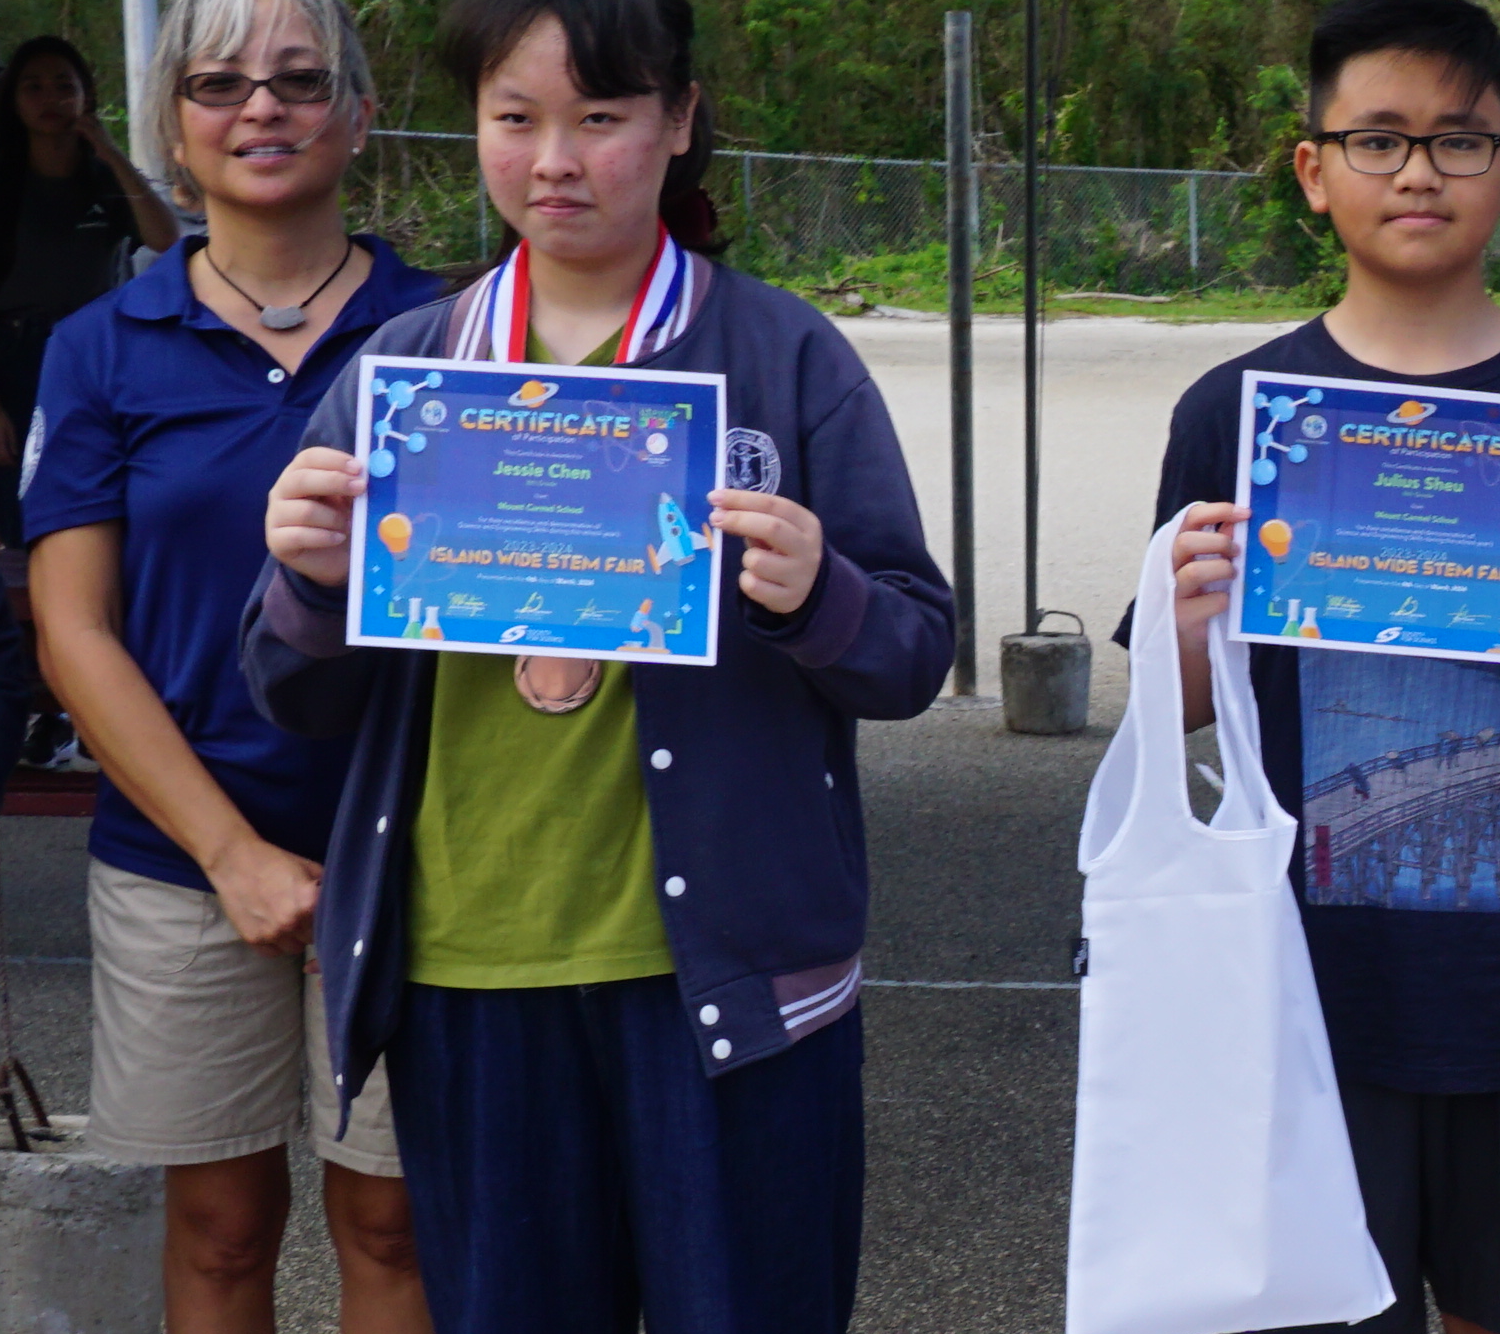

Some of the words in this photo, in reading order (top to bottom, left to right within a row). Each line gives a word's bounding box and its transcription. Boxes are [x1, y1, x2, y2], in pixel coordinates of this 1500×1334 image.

[459, 407, 632, 438] CERTIFICATE
[493, 461, 544, 477] Jessie
[548, 463, 592, 480] Chen
[1374, 472, 1420, 489] Julius
[1426, 475, 1464, 493] Sheu
[429, 546, 493, 565] ISLAND
[497, 550, 543, 568] WIDE
[547, 553, 601, 571] STEM
[605, 557, 645, 574] FAIR
[1308, 551, 1369, 570] ISLAND
[1373, 557, 1419, 574] WIDE
[1423, 561, 1474, 578] STEM
